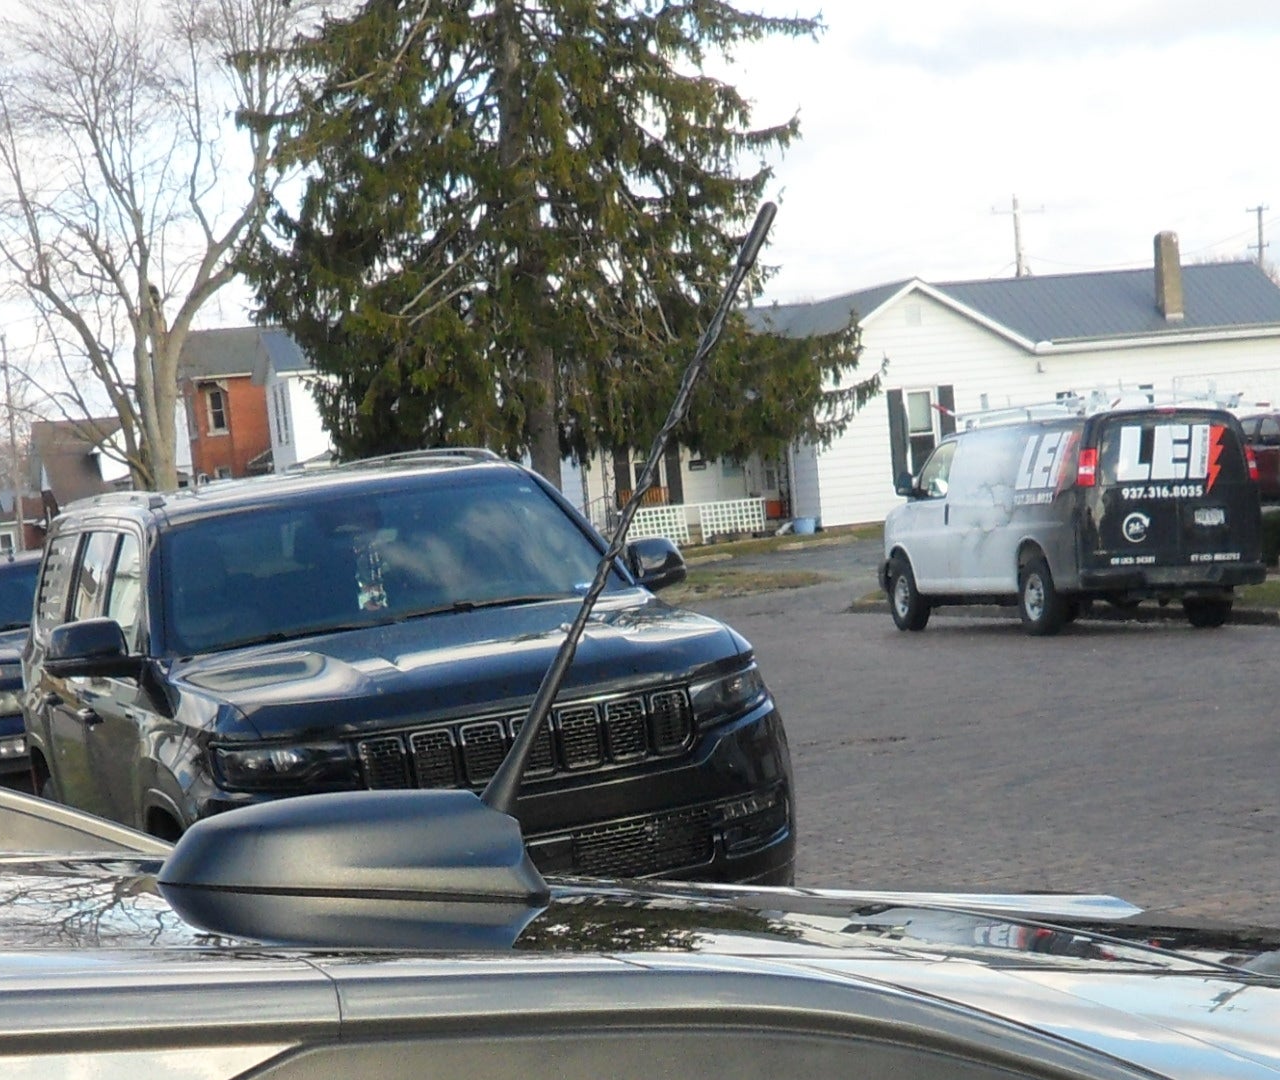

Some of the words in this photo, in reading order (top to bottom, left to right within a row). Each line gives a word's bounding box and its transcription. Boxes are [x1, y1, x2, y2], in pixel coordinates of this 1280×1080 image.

[1015, 431, 1073, 490] LEI
[1117, 424, 1210, 480] LEI
[1122, 485, 1203, 499] 937.316.8035
